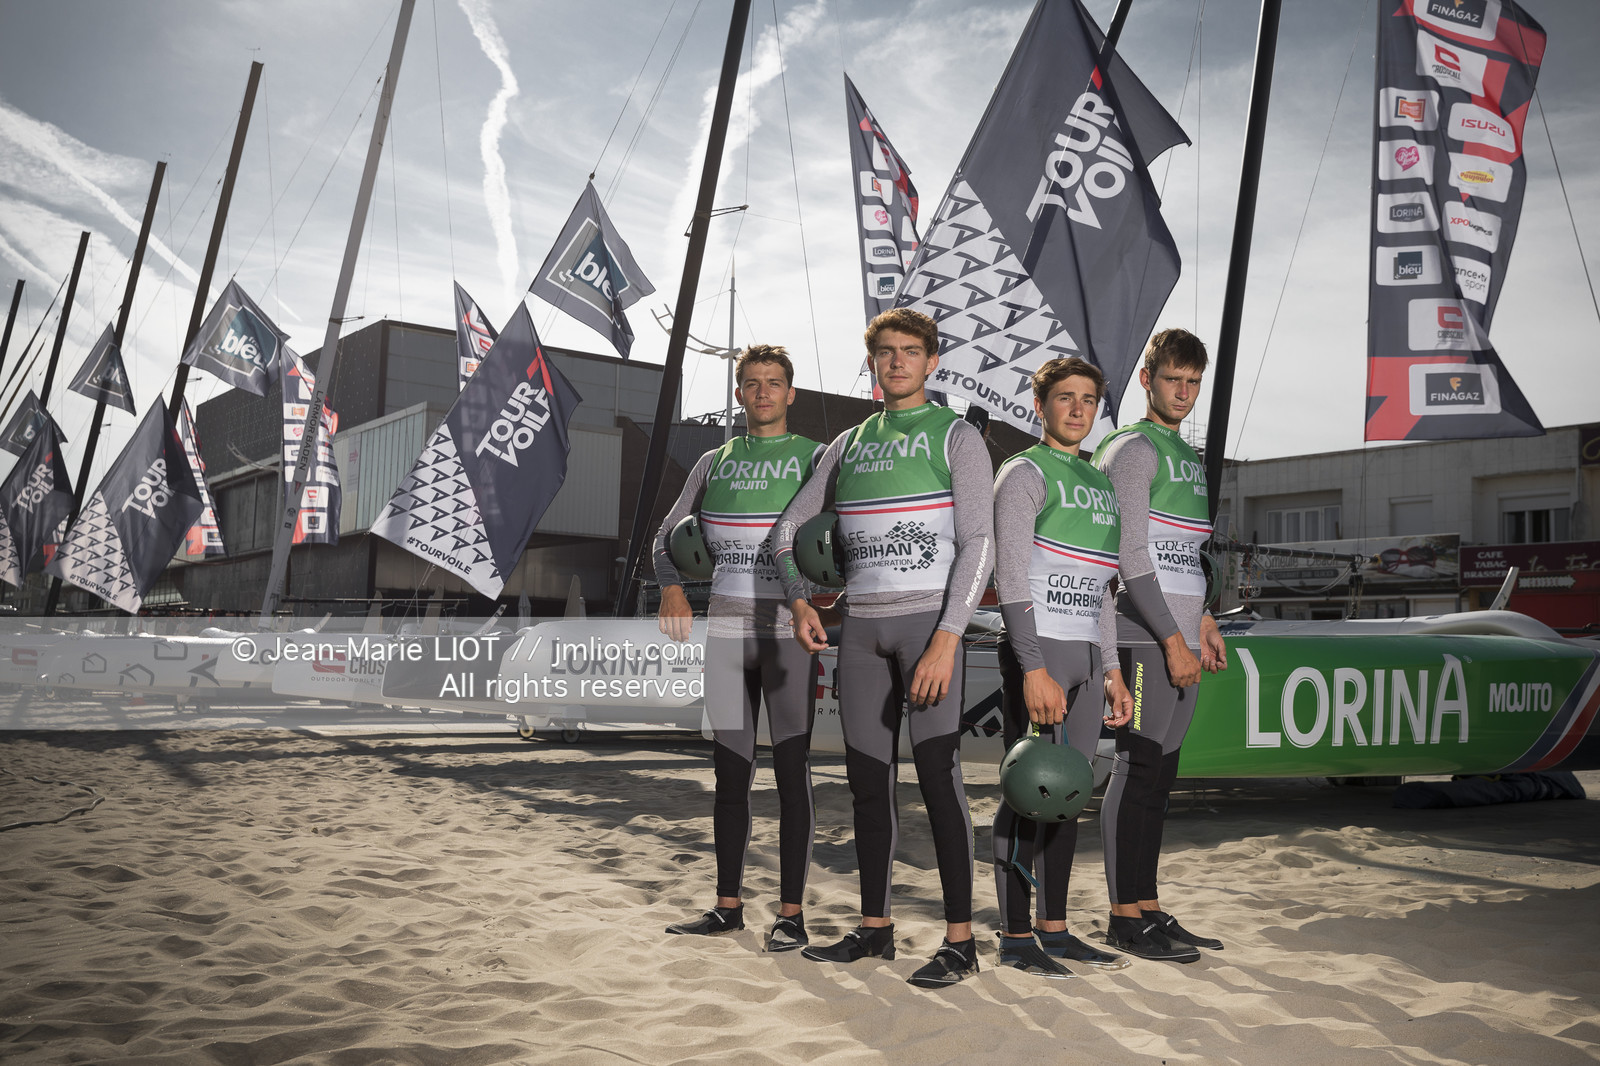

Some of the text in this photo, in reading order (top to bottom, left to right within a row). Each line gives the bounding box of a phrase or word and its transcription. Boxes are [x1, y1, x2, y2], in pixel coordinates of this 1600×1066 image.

[1431, 4, 1480, 23] FINAGAZ
[1461, 118, 1506, 137] ISUZU
[1025, 92, 1114, 223] TOUR
[1392, 206, 1424, 218] LORINA
[874, 247, 895, 256] LORINA
[1399, 265, 1422, 275] bleu
[880, 285, 895, 293] bleu
[935, 368, 1043, 427] #TOURVOIL
[1431, 392, 1480, 401] FINAGAZ
[306, 390, 324, 433] LARMOR
[475, 381, 540, 458] TOUR
[299, 436, 316, 472] BADEN
[844, 431, 931, 464] ORINA
[1049, 450, 1071, 463] LORINA
[853, 459, 894, 475] MOJITO
[1165, 455, 1208, 484] LORIN
[12, 463, 48, 509] TOUR
[122, 458, 167, 513] TOUR
[730, 480, 768, 490] MOJITO
[1056, 480, 1119, 517] LORIN
[406, 536, 473, 575] #TOURVOILE
[714, 552, 776, 567] ORBIHAN
[846, 542, 912, 563] ORBIHAN
[1477, 551, 1504, 559] CAFE
[1158, 563, 1185, 574] VANNES
[1463, 570, 1508, 579] BRASSER
[1474, 560, 1508, 569] TABAC
[70, 574, 118, 601] #TOURVOILE
[965, 576, 981, 608] MAGIC
[1047, 573, 1098, 592] GOLFE
[1047, 605, 1074, 616] VANNES
[1133, 662, 1144, 731] MAGIC MARINE
[1235, 647, 1469, 748] LORINA
[1488, 682, 1553, 713] MOJITO
